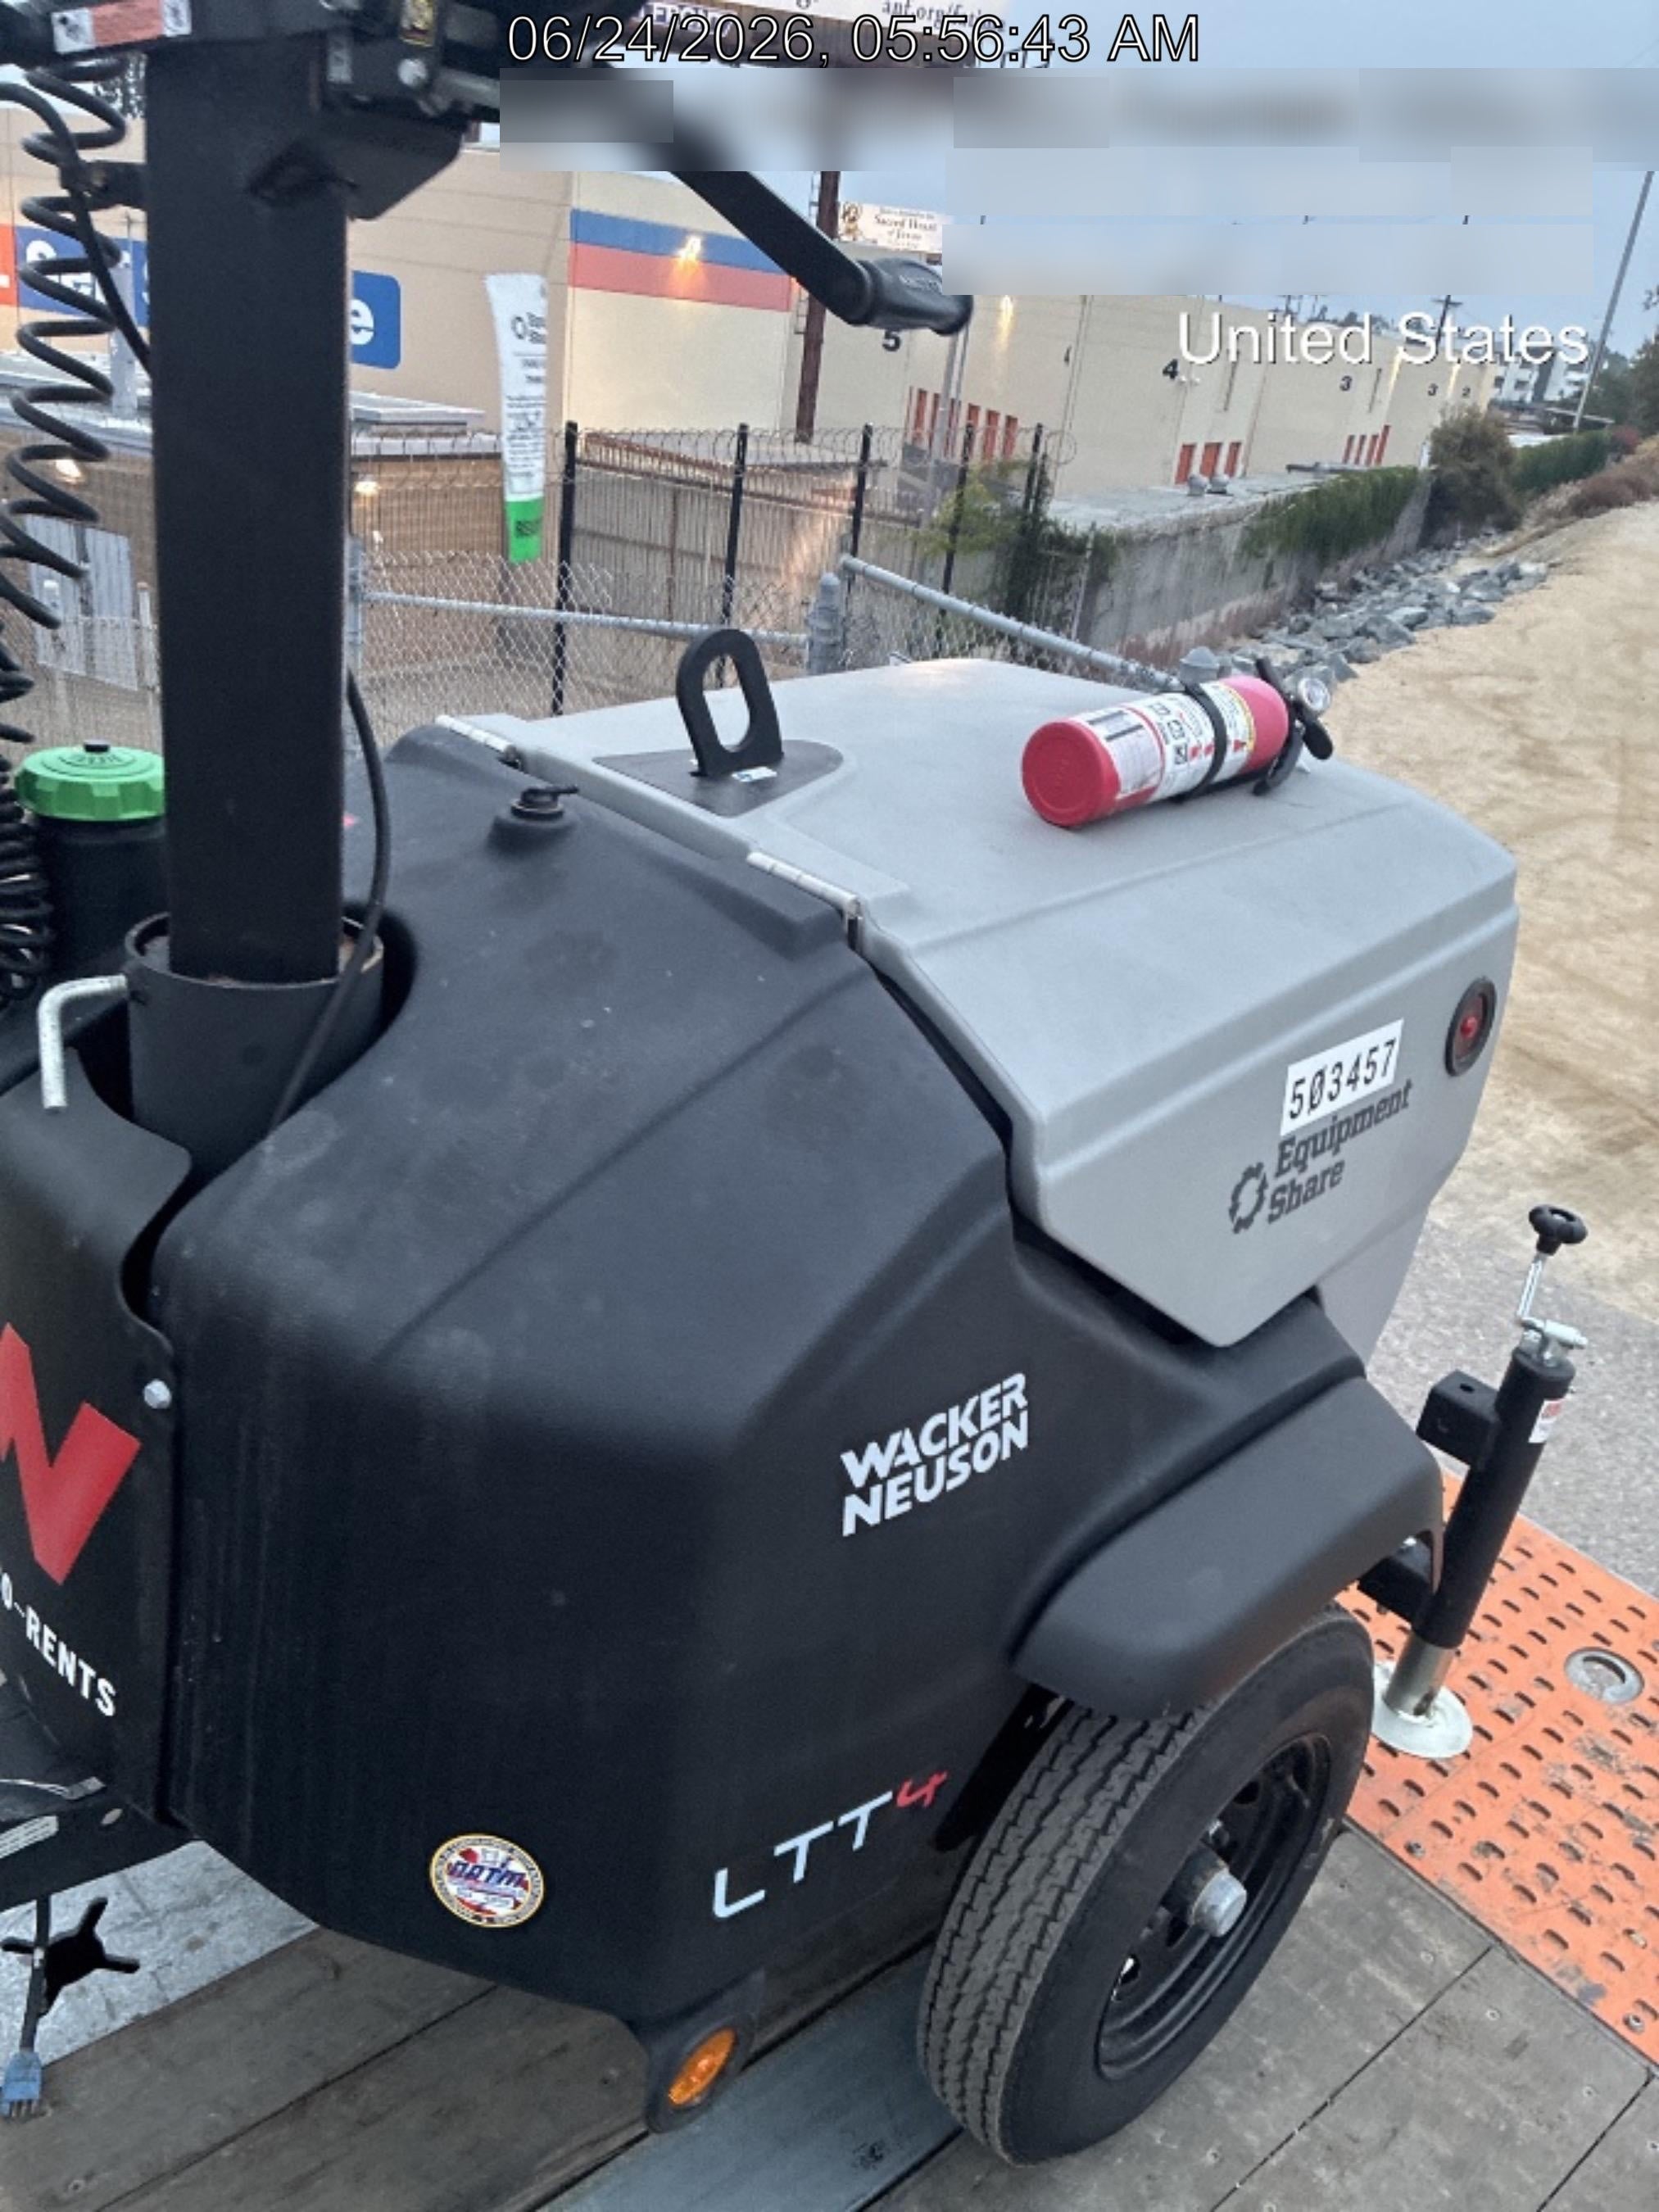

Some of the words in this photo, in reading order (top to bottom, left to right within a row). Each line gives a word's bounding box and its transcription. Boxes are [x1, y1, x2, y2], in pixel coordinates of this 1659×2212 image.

[882, 329, 901, 352] 5
[1162, 358, 1180, 380] 4
[1339, 374, 1353, 392] 3
[1288, 1037, 1398, 1120] 503457
[1274, 1077, 1414, 1179] Equipment
[1267, 1158, 1346, 1225] Share
[839, 1372, 1028, 1489] WACKER
[842, 1409, 1029, 1537] NEUSON
[0, 1566, 116, 1718] O-RENTS
